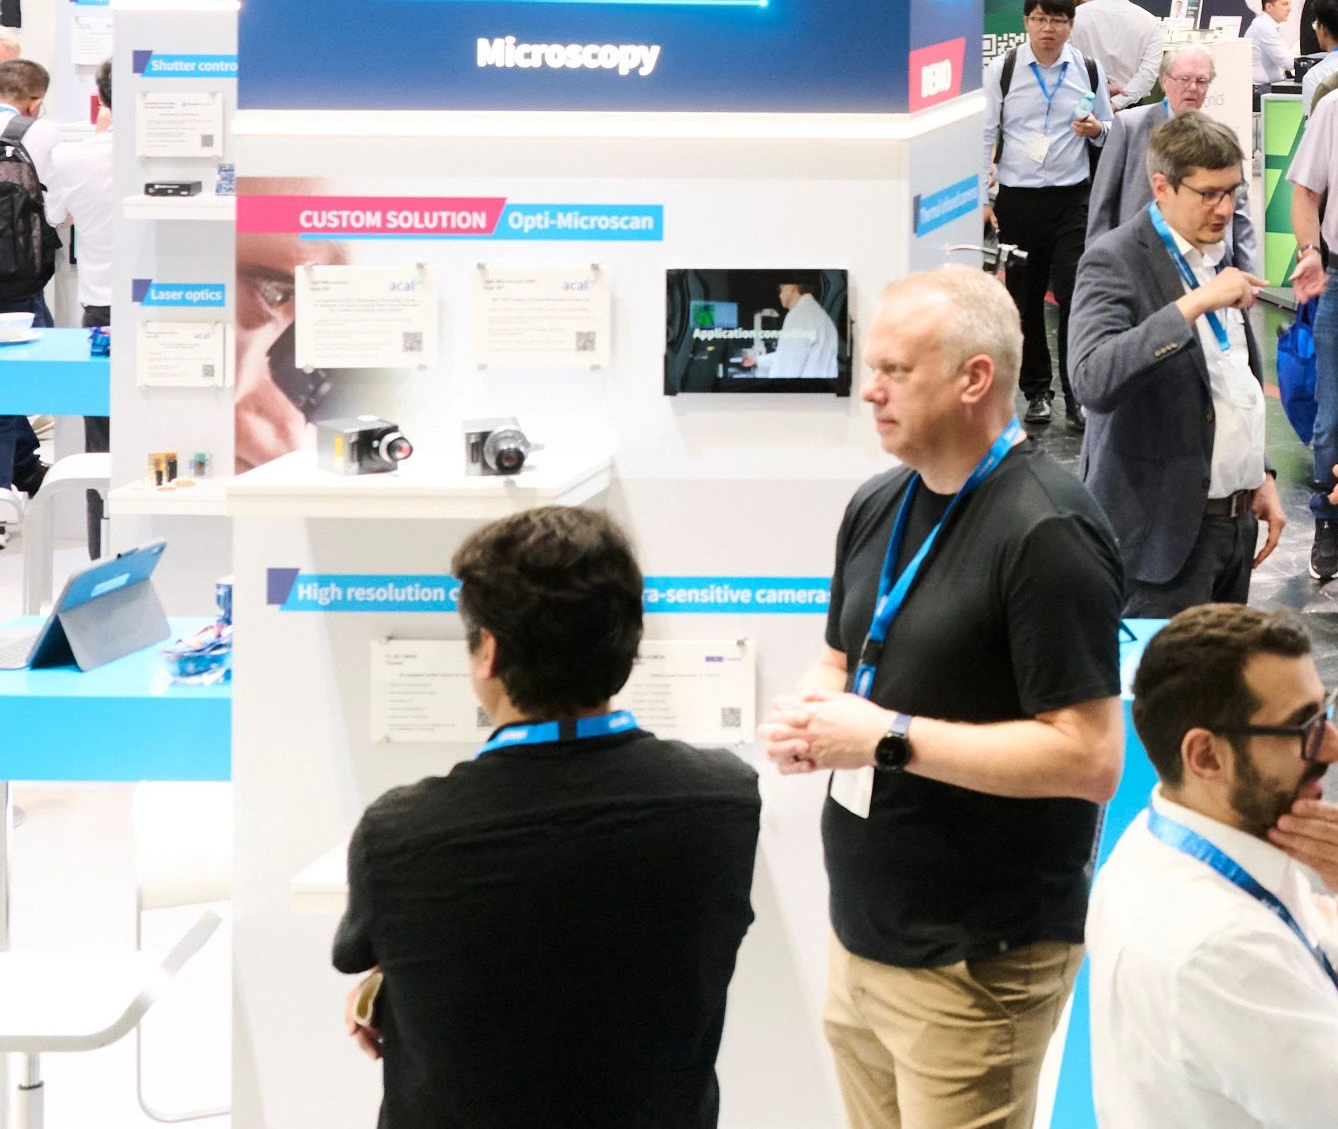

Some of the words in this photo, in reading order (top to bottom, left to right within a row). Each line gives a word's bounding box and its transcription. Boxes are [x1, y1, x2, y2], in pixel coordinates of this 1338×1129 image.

[151, 59, 196, 72] Shutter
[476, 36, 661, 79] Microscopy
[921, 59, 952, 98] DEMO
[300, 211, 382, 230] CUSTOM
[386, 211, 487, 230] SOLUTION
[508, 211, 654, 233] Opti-Microscan
[150, 287, 183, 301] Laser
[185, 288, 222, 304] optics
[693, 326, 755, 343] Application
[297, 581, 342, 605] High
[346, 582, 446, 603] resolution
